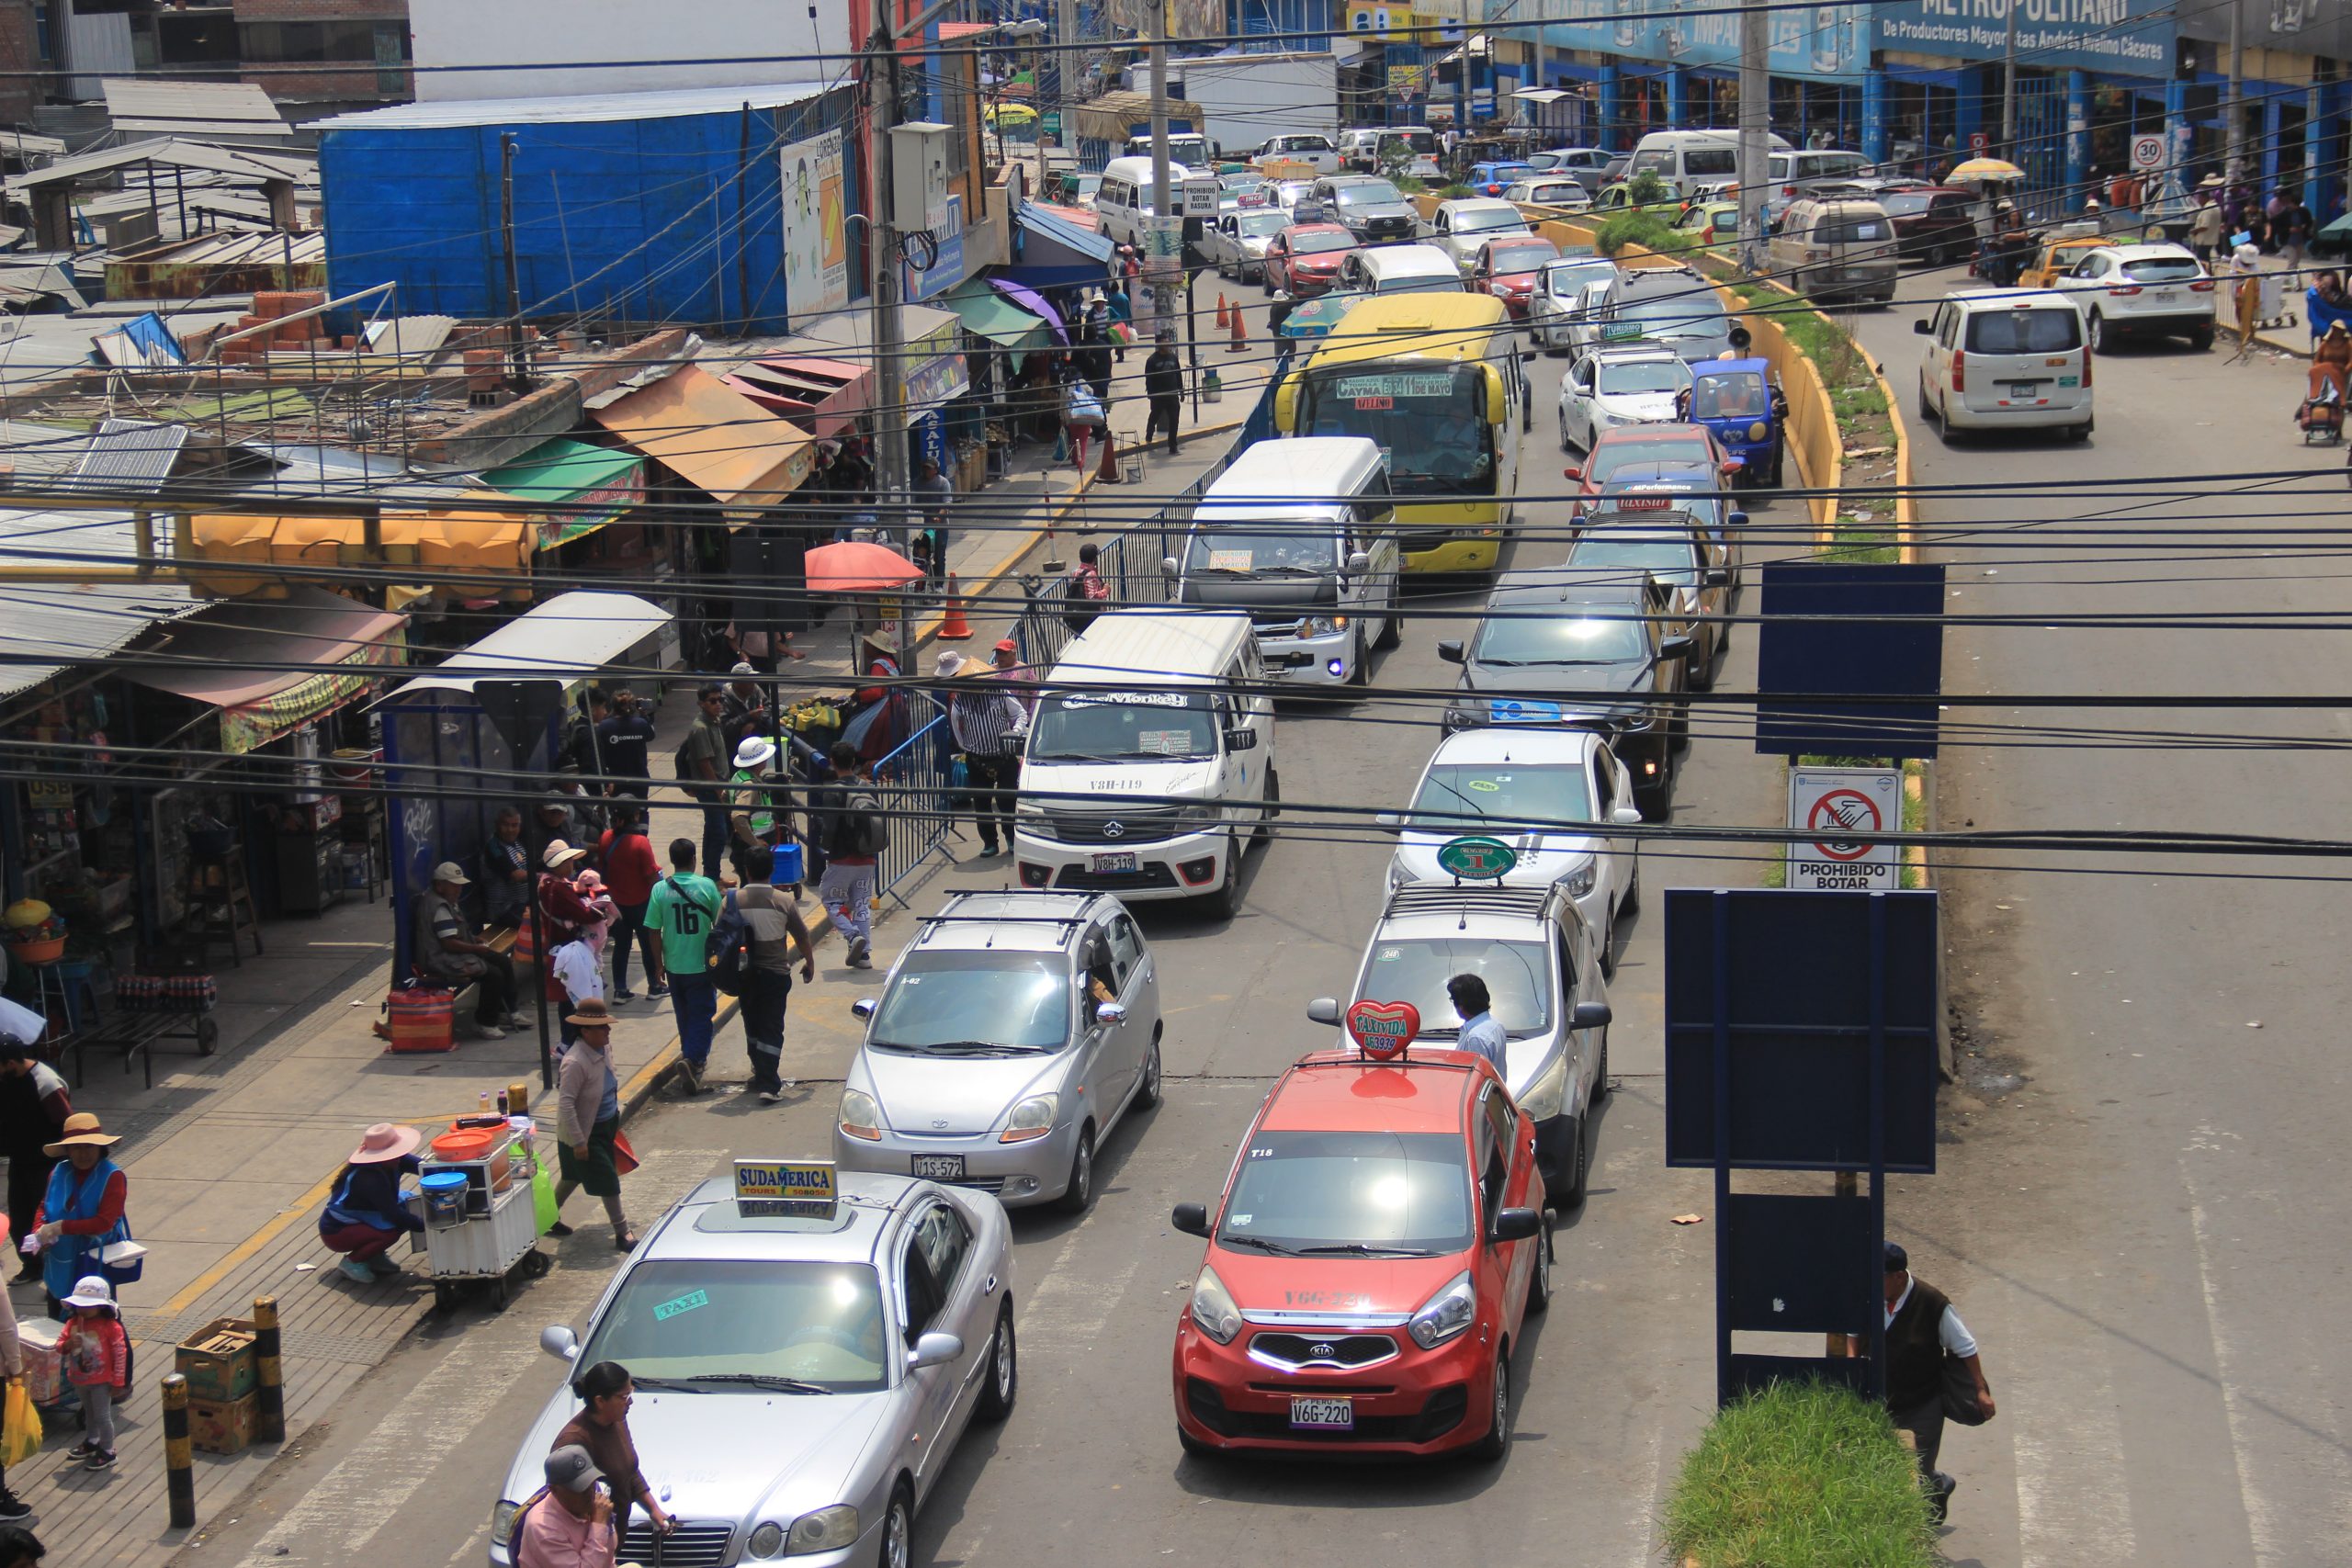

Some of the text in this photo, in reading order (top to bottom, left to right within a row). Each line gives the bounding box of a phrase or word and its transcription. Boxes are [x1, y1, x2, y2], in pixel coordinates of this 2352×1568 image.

[1693, 16, 1804, 55] IMPALES
[1883, 19, 1897, 36] De
[1899, 20, 1969, 43] Productores
[1971, 26, 2037, 48] Mayortas
[2082, 34, 2120, 55] Avelino
[2120, 36, 2164, 61] Cáceres
[816, 135, 842, 158] LORENZO
[2141, 144, 2158, 156] 30
[1606, 325, 1641, 333] TURISMO
[1416, 385, 1451, 395] DE MAYO
[1356, 398, 1392, 408] AVELINO
[1108, 693, 1189, 707] Monkey
[1091, 780, 1143, 791] V8H-119
[1097, 858, 1134, 871] V8H-119
[1800, 864, 1886, 877] PROHIBIDO
[1816, 877, 1869, 889] BOTAR
[672, 902, 699, 935] 16
[900, 976, 921, 985] A-02
[1363, 1035, 1396, 1052] 463939
[1251, 1149, 1272, 1157] T18
[915, 1161, 961, 1176] V1S-572
[740, 1168, 830, 1189] SUDAMERICA
[659, 1292, 703, 1314] TAXI
[1285, 1291, 1373, 1305] V6G-220
[1314, 1347, 1331, 1355] KIA
[1294, 1405, 1351, 1423] V6G-220
